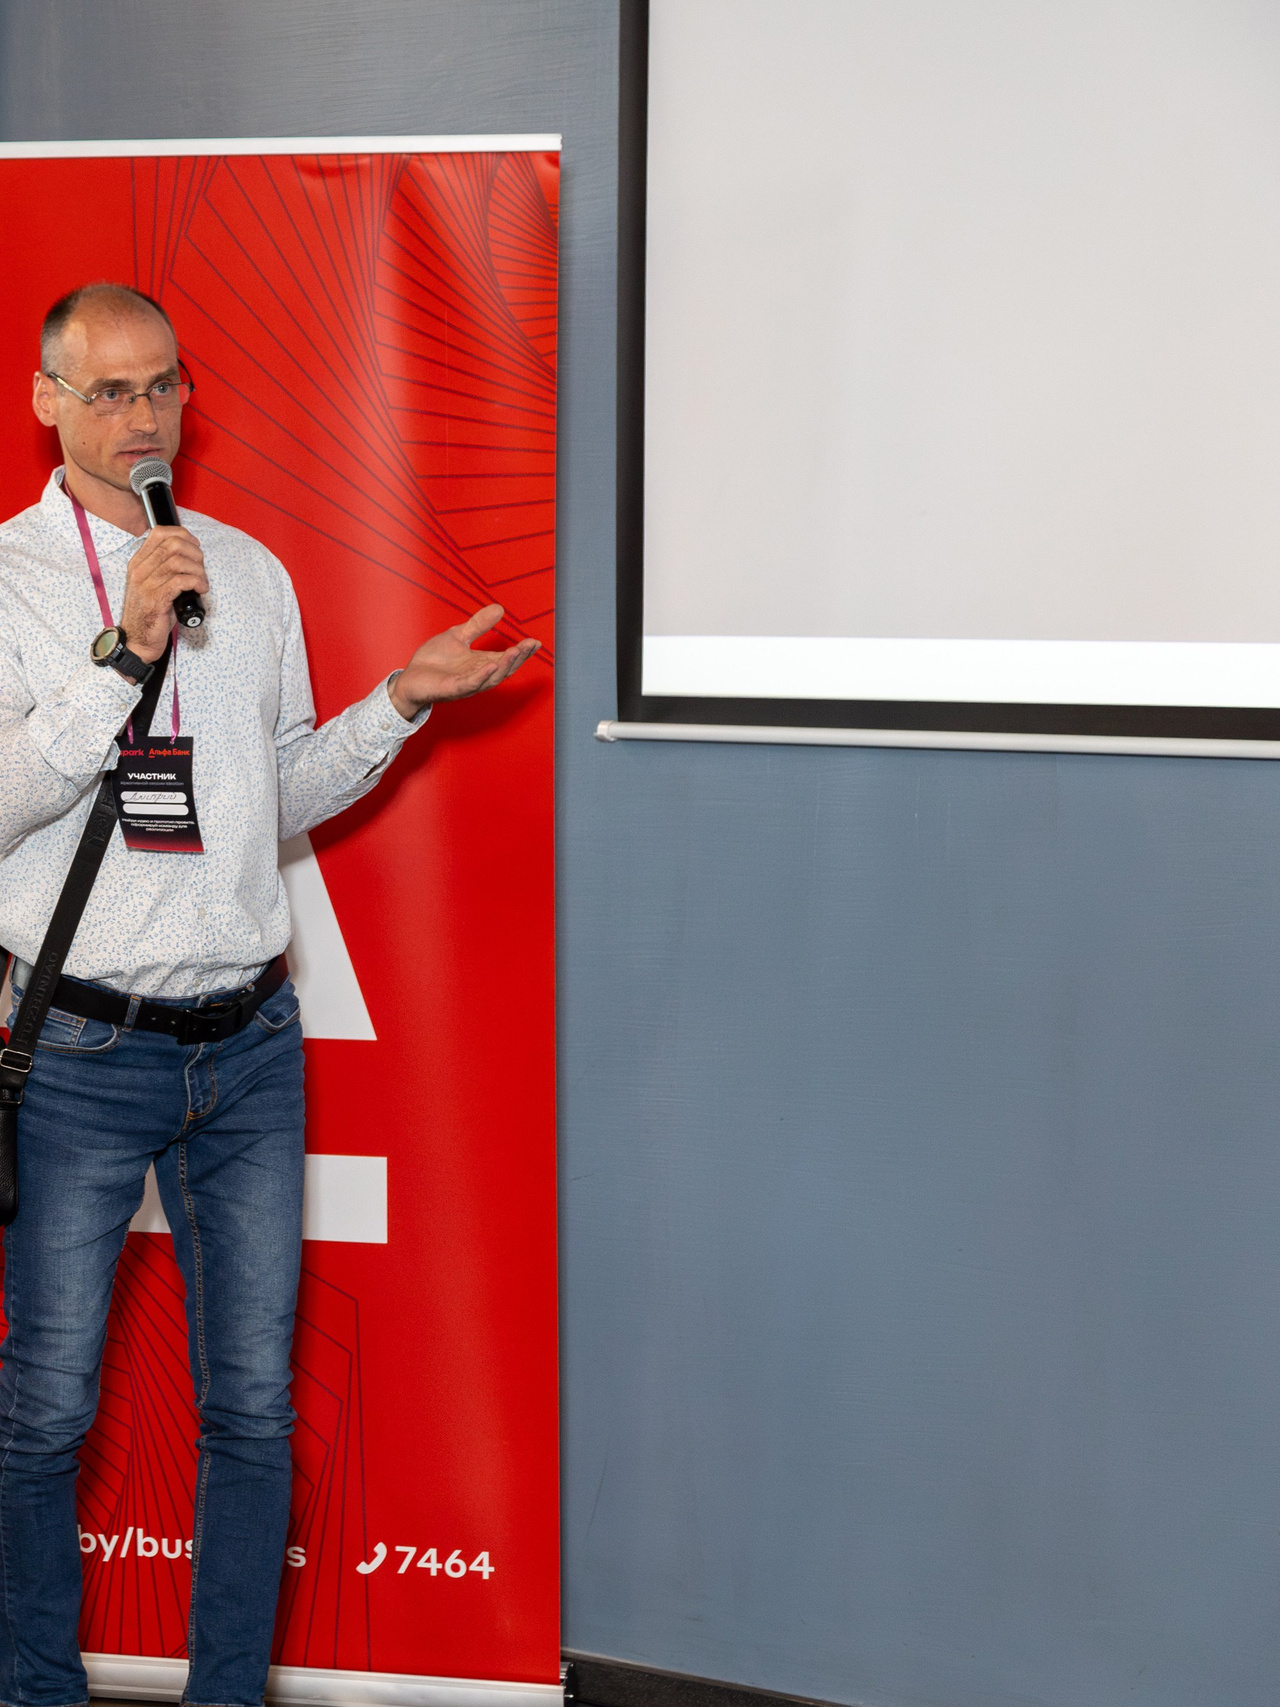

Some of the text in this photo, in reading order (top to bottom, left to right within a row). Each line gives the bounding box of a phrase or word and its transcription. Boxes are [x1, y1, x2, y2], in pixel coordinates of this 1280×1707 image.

[149, 748, 190, 758] Альфа Банк
[395, 1546, 495, 1580] 7464
